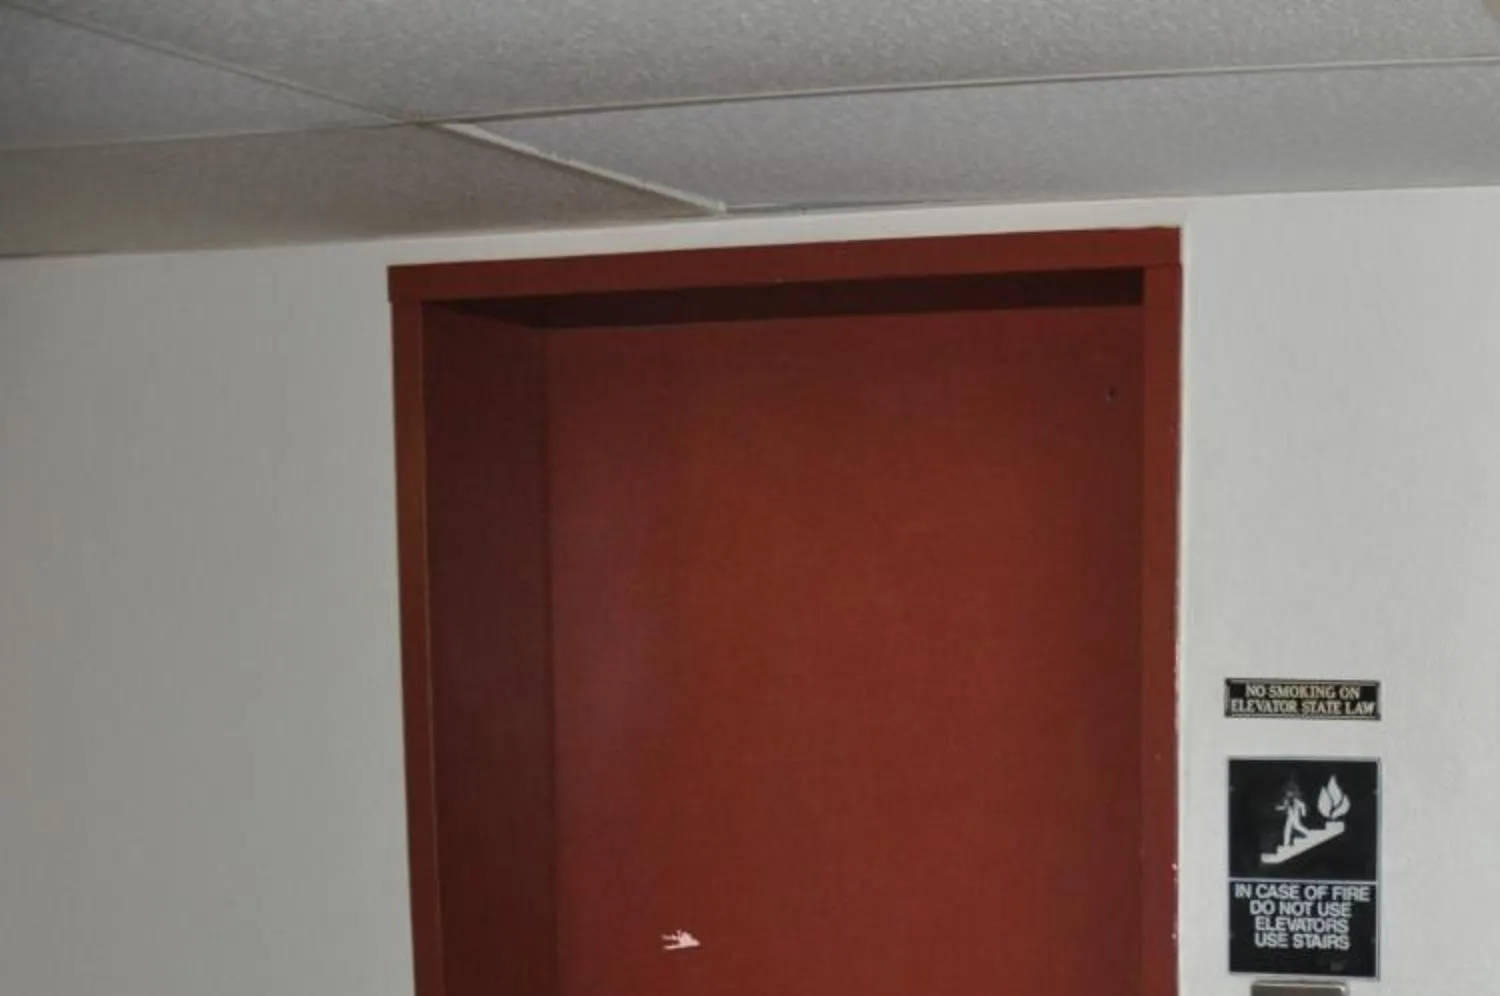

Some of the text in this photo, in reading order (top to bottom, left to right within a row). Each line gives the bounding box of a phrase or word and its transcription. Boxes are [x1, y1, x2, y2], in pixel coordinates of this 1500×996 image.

[1246, 685, 1361, 699] NO SMOKING ON
[1231, 699, 1375, 715] ELEVATOR STATE LAW
[1235, 884, 1370, 901] IN CASE OF FIRE
[1250, 900, 1352, 917] DO NOT USE
[1255, 916, 1349, 933] ELEVATORS
[1255, 932, 1350, 950] USE STAIRS
